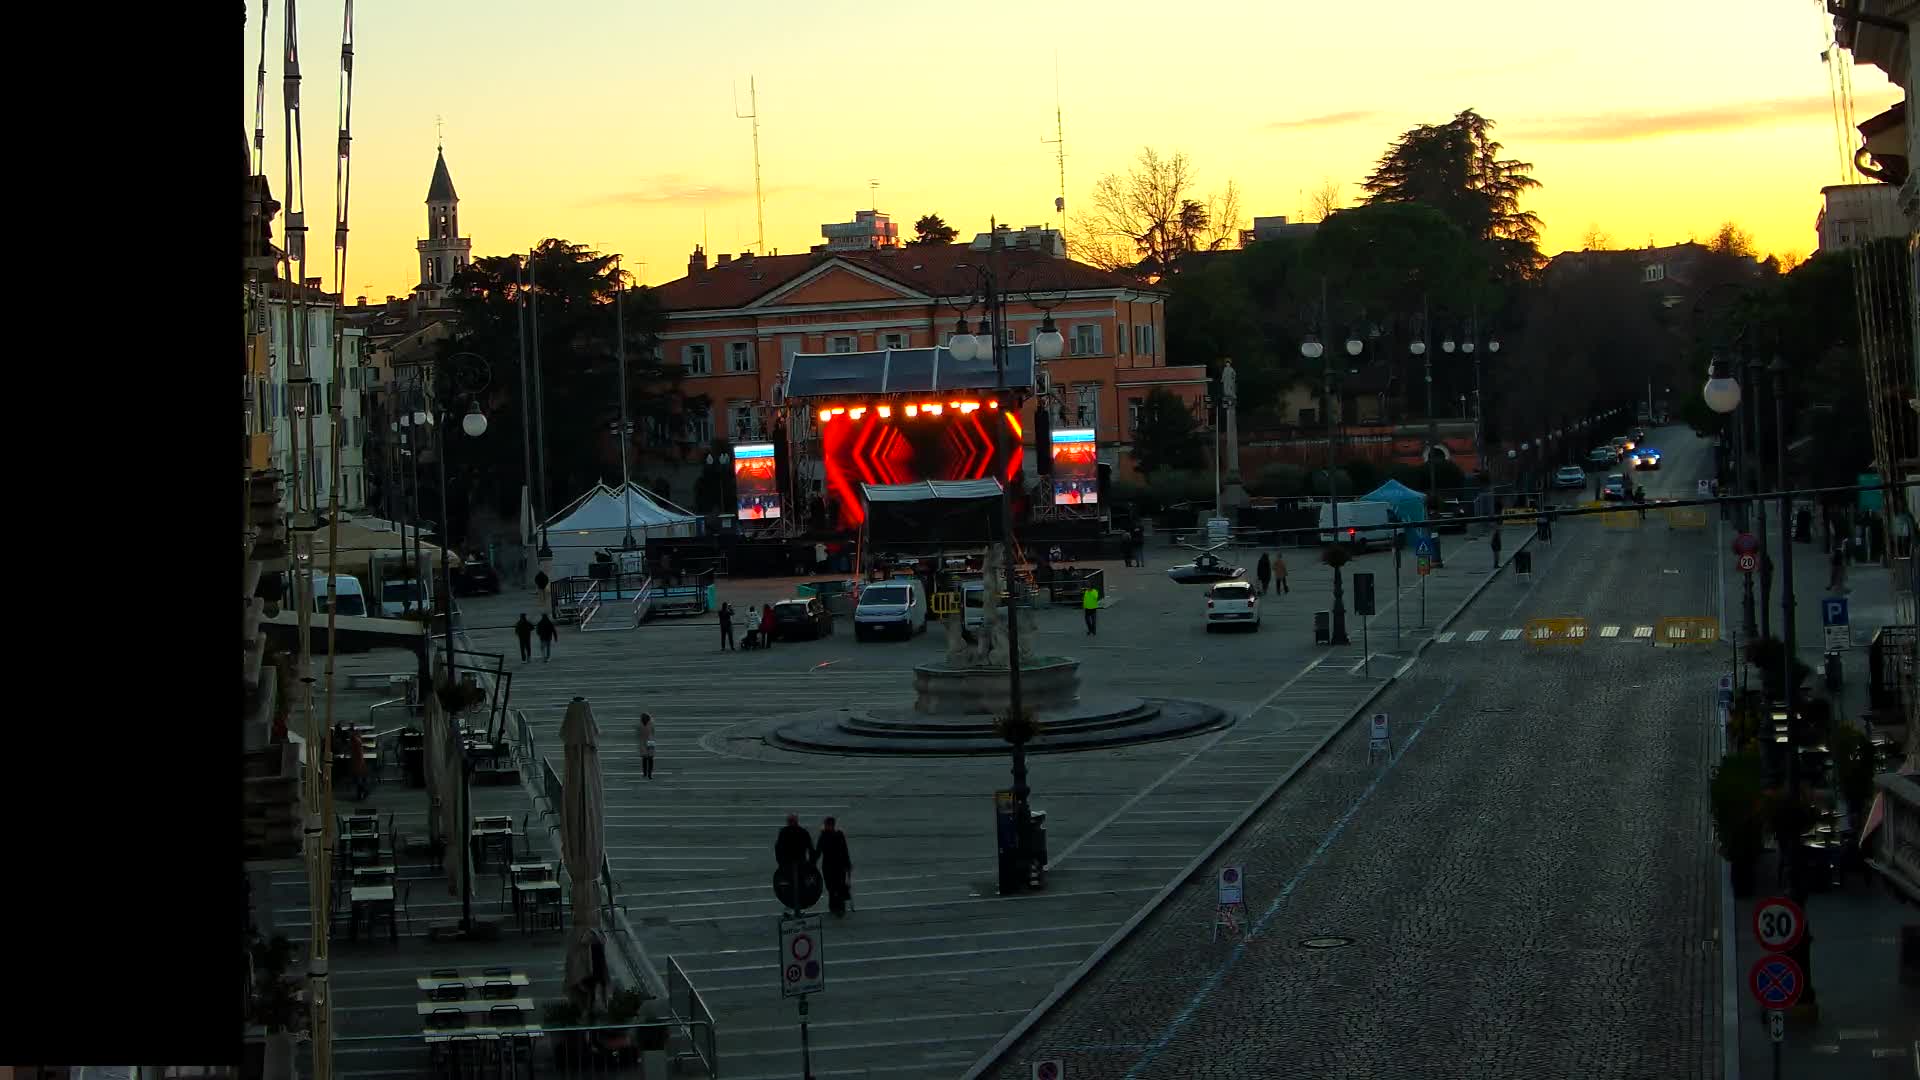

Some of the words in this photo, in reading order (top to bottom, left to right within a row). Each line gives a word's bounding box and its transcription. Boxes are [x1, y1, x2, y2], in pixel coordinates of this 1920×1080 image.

[1742, 557, 1753, 567] 20
[1827, 602, 1842, 623] P
[1762, 912, 1792, 938] 30
